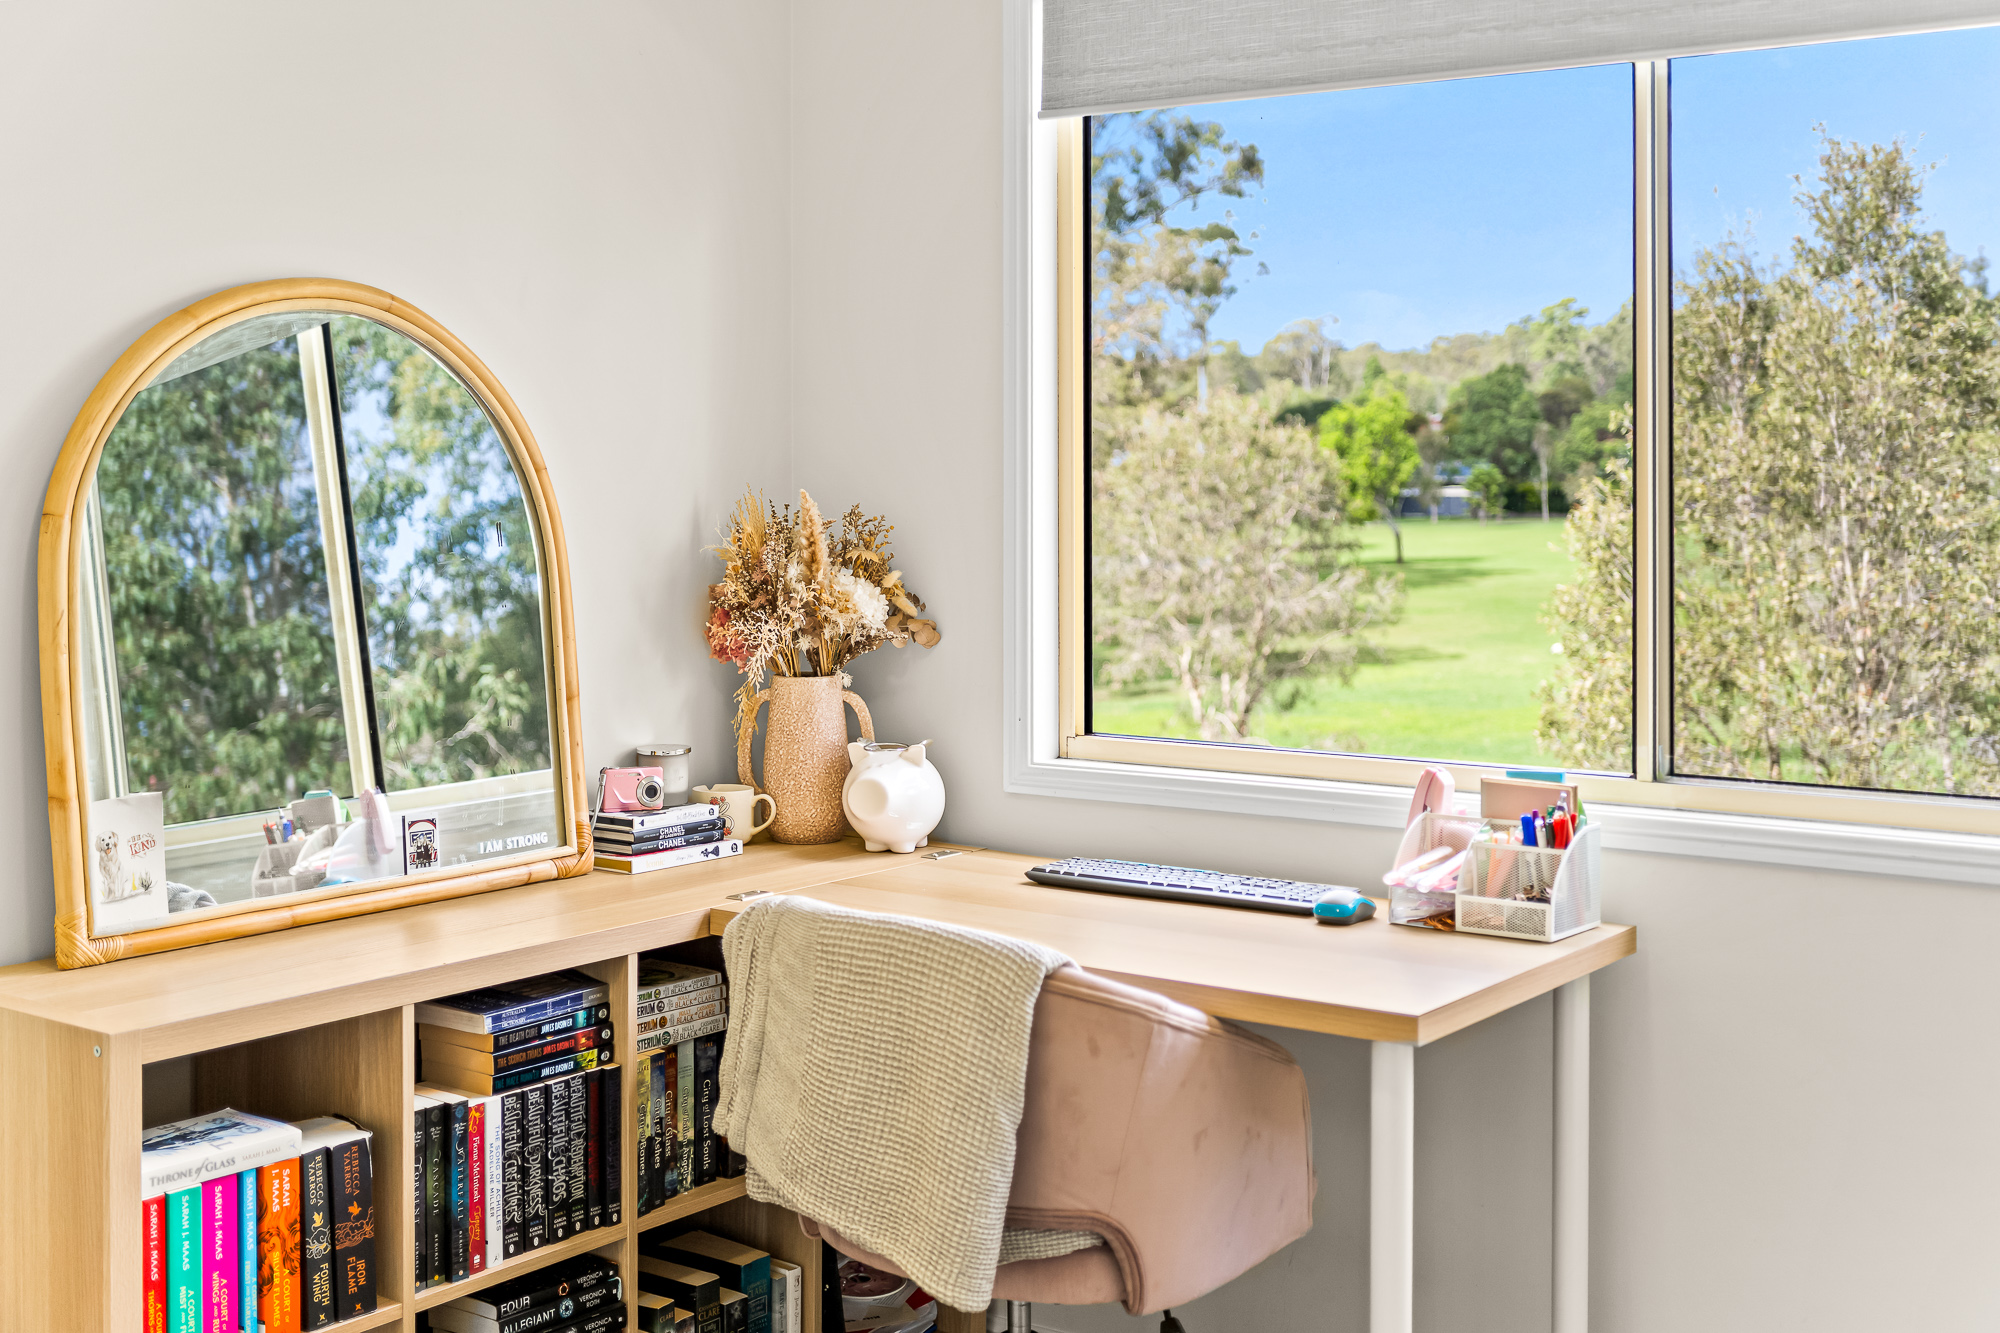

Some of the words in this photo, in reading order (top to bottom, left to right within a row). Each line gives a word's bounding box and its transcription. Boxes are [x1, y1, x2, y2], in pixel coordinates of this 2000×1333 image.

[479, 842, 484, 854] I
[486, 840, 503, 853] AM
[506, 832, 549, 850] STRONG
[658, 838, 686, 849] CHANEL
[660, 825, 685, 834] CHANEL
[130, 840, 156, 855] KIND
[670, 986, 688, 994] BLACK
[692, 981, 709, 989] CLARE
[674, 1000, 693, 1008] BLACK
[676, 1014, 694, 1023] BLACK
[698, 1008, 715, 1017] CLARE
[498, 1035, 508, 1046] THE
[509, 1031, 525, 1041] DEATH
[525, 1027, 538, 1038] CURE
[541, 1022, 555, 1034] JAMES
[555, 1018, 573, 1029] DASHNER
[680, 1030, 698, 1040] BLACK
[702, 1024, 720, 1035] CLARE
[497, 1057, 507, 1068] THE
[508, 1051, 526, 1065] SCORCH
[527, 1048, 542, 1060] TRIALS
[543, 1043, 556, 1055] JAMES
[556, 1039, 575, 1051] DASHNER
[541, 1065, 555, 1077] JAMES
[555, 1061, 574, 1073] DASHNER
[665, 1090, 673, 1116] City
[682, 1086, 690, 1107] City
[702, 1079, 711, 1103] City
[552, 1083, 568, 1153] BEAUTIFUL
[569, 1077, 586, 1138] BEAUTIFUL
[638, 1104, 646, 1130] City
[653, 1098, 662, 1123] City
[667, 1116, 672, 1125] of
[703, 1104, 710, 1112] of
[504, 1096, 522, 1158] BEAUTIFUL
[527, 1090, 546, 1154] BEAUTIFUL
[655, 1125, 662, 1135] of
[703, 1114, 711, 1138] Lost
[654, 1136, 662, 1169] Ashes
[665, 1126, 674, 1157] Glass
[703, 1140, 711, 1170] Souls
[150, 1168, 193, 1187] THRONE
[192, 1157, 209, 1182] of
[205, 1157, 236, 1173] GLASS
[242, 1152, 260, 1161] SARAH
[343, 1151, 352, 1195] YARROS
[351, 1145, 360, 1196] REBECCA
[570, 1137, 586, 1202] REDEMPTION
[682, 1146, 690, 1179] Angels
[308, 1162, 316, 1205] YARROS
[315, 1154, 324, 1207] REBECCA
[432, 1150, 441, 1216] CASCADE
[456, 1142, 465, 1222] WATERFALL
[495, 1172, 501, 1184] OF
[503, 1155, 523, 1224] CREATURES
[526, 1154, 546, 1218] DARKNESS
[552, 1154, 568, 1202] CHAOS
[214, 1185, 223, 1220] SARAH
[272, 1179, 280, 1212] MAAS
[215, 1230, 223, 1260] MAAS
[150, 1250, 158, 1281] MAAS
[347, 1256, 358, 1295] FLAME
[356, 1259, 366, 1286] IRON
[577, 1271, 603, 1284] VERONICA
[283, 1279, 291, 1312] COURT
[312, 1272, 322, 1303] WING
[320, 1263, 330, 1306] FOURTH
[579, 1288, 607, 1302] VERONICA
[583, 1279, 597, 1288] ROTH
[220, 1289, 229, 1322] COURT
[500, 1295, 531, 1315] FOUR
[585, 1298, 600, 1308] ROTH
[660, 1311, 674, 1323] CLARE
[698, 1307, 720, 1321] CLARE
[504, 1308, 556, 1333] ALLEGIANT
[584, 1316, 612, 1331] VERONICA
